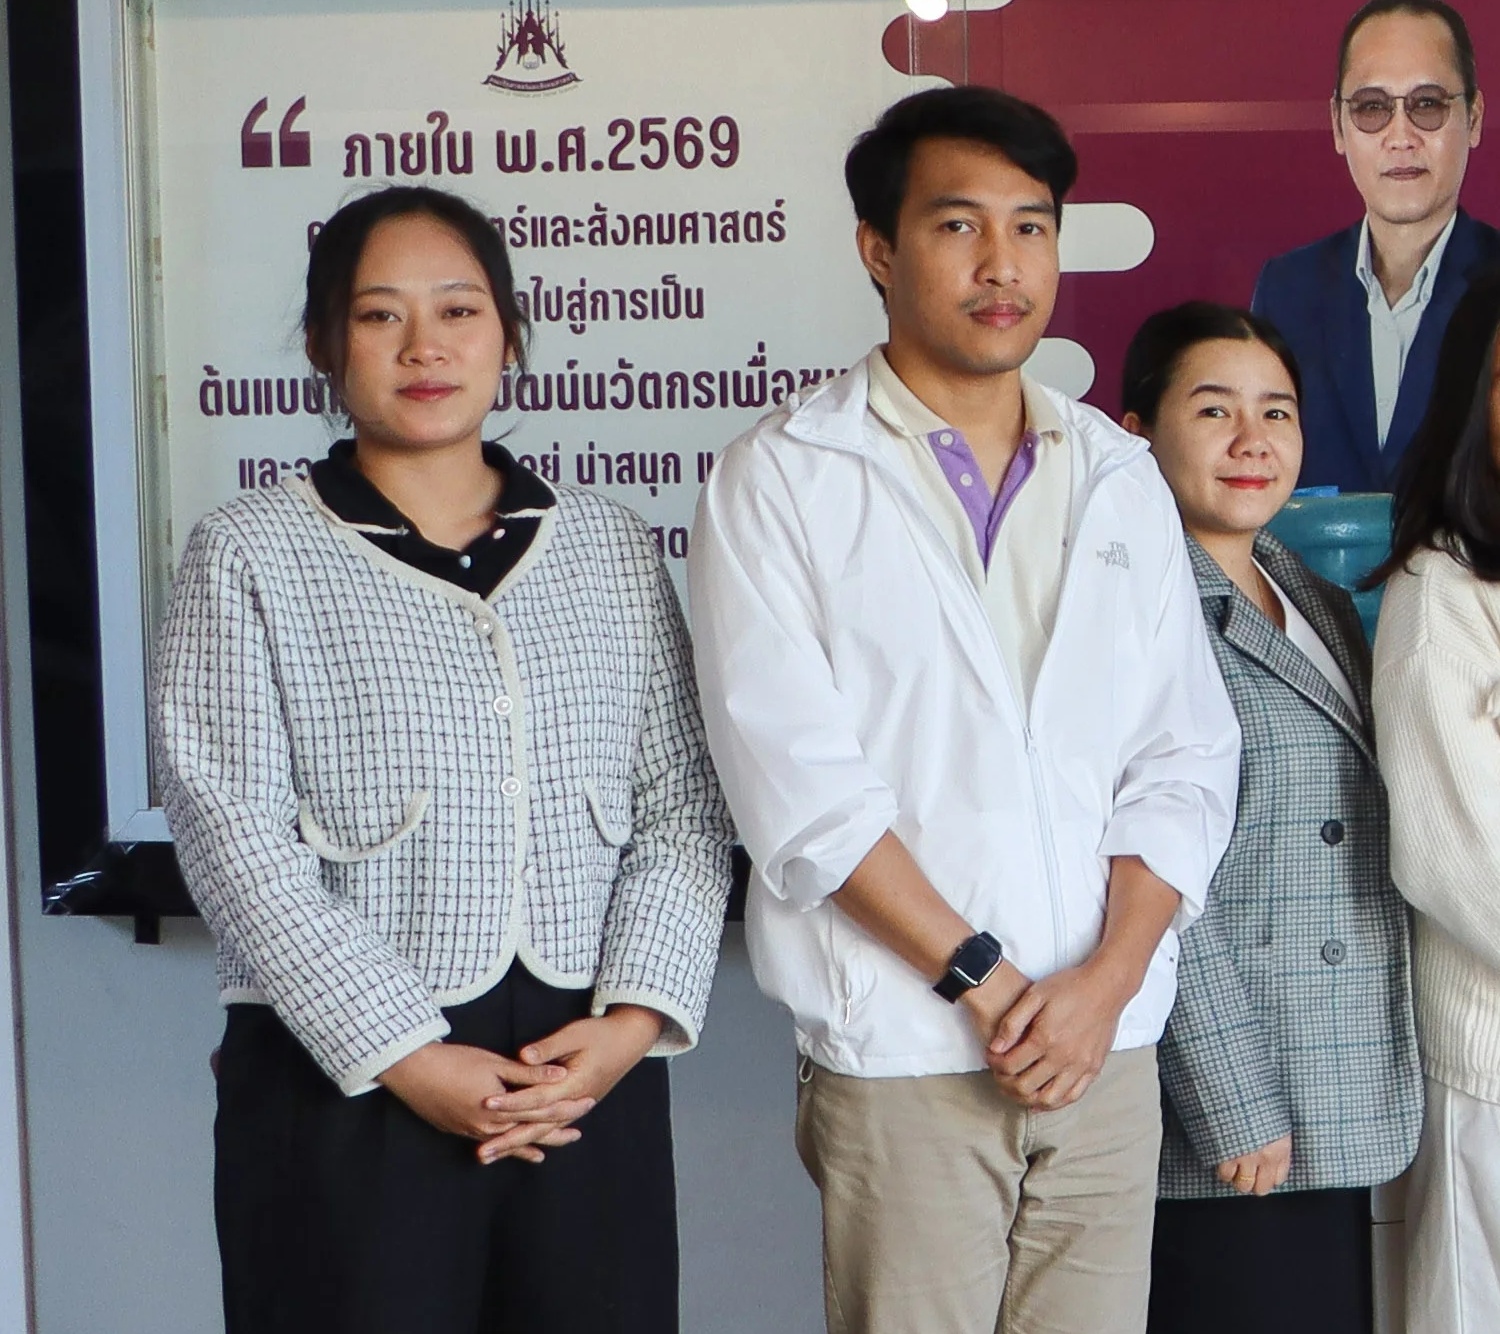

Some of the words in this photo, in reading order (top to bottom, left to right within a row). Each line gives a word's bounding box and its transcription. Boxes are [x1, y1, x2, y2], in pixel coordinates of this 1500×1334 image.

[342, 110, 474, 178] ภายใน
[496, 115, 740, 174] พ.ศ.2569
[576, 441, 681, 498] น่าสนุก
